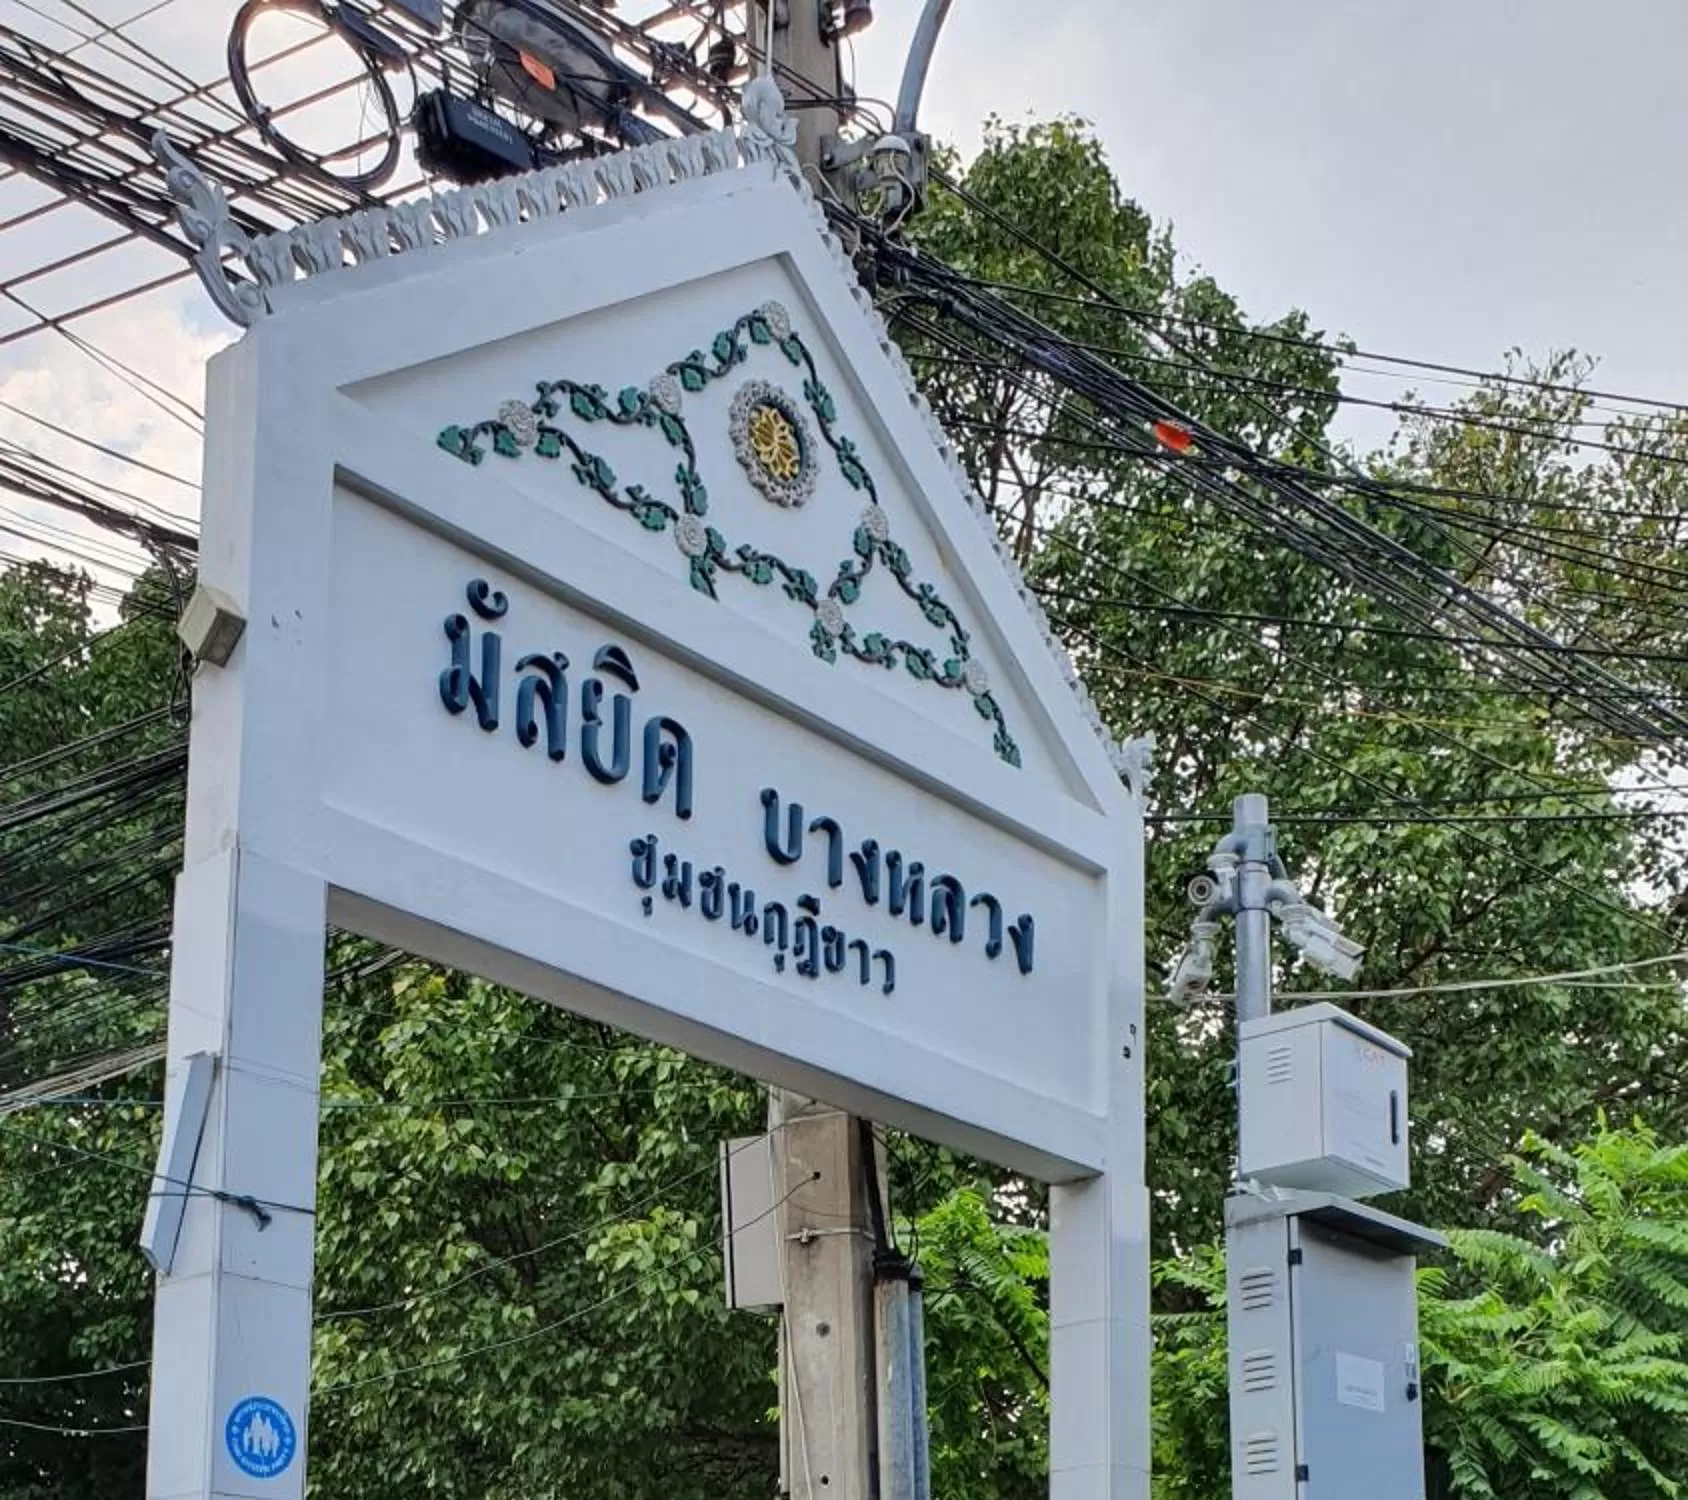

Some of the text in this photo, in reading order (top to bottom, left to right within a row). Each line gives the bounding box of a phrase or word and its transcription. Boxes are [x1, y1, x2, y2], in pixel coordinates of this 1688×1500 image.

[439, 578, 1035, 976] มัสยิด บางหลวง
